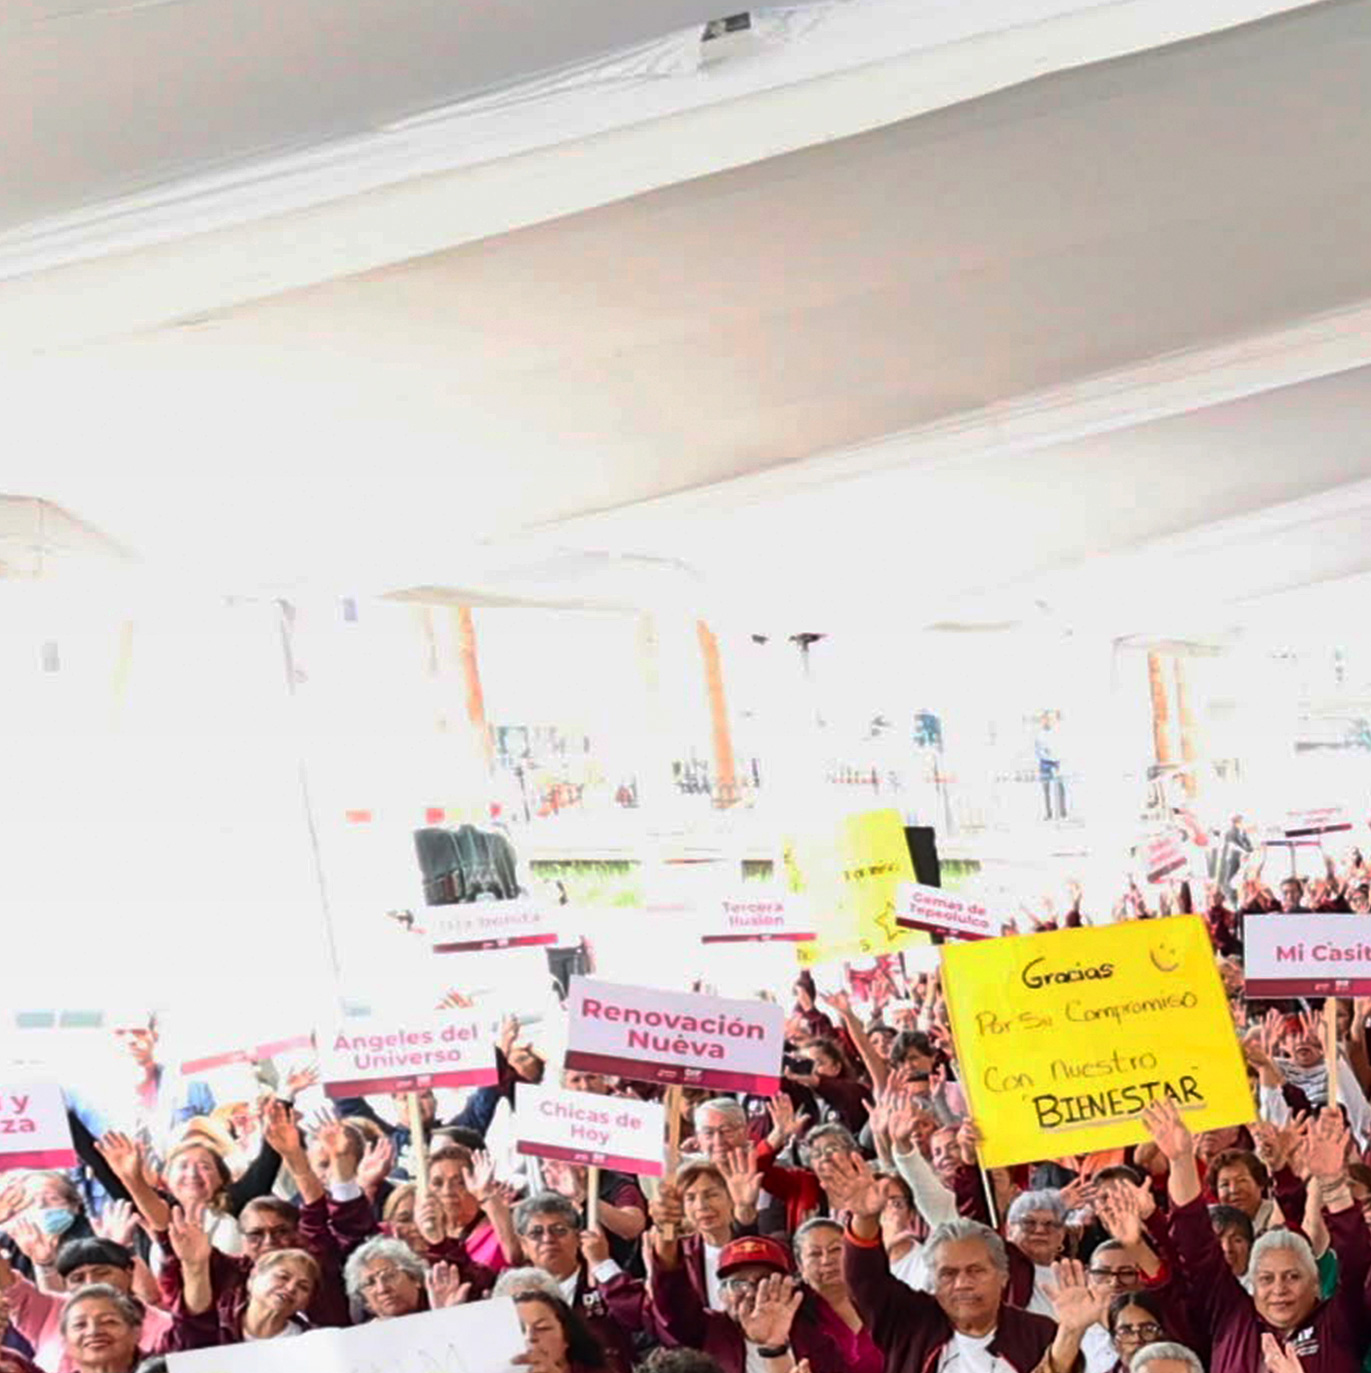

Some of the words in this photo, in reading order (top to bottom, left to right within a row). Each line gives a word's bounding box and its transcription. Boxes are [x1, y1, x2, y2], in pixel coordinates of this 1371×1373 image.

[1275, 943, 1304, 962] Mi
[1021, 957, 1114, 989] Gracias
[580, 998, 766, 1041] Renovación
[1065, 991, 1198, 1024] Compromiso
[441, 1024, 478, 1043] del
[627, 1029, 726, 1060] Nueva
[354, 1048, 462, 1070] Universo
[984, 1066, 1034, 1093] Con
[538, 1100, 611, 1125] Chicas
[616, 1112, 642, 1131] de
[1033, 1075, 1204, 1129] BIENESTAR
[570, 1123, 610, 1147] Hoy
